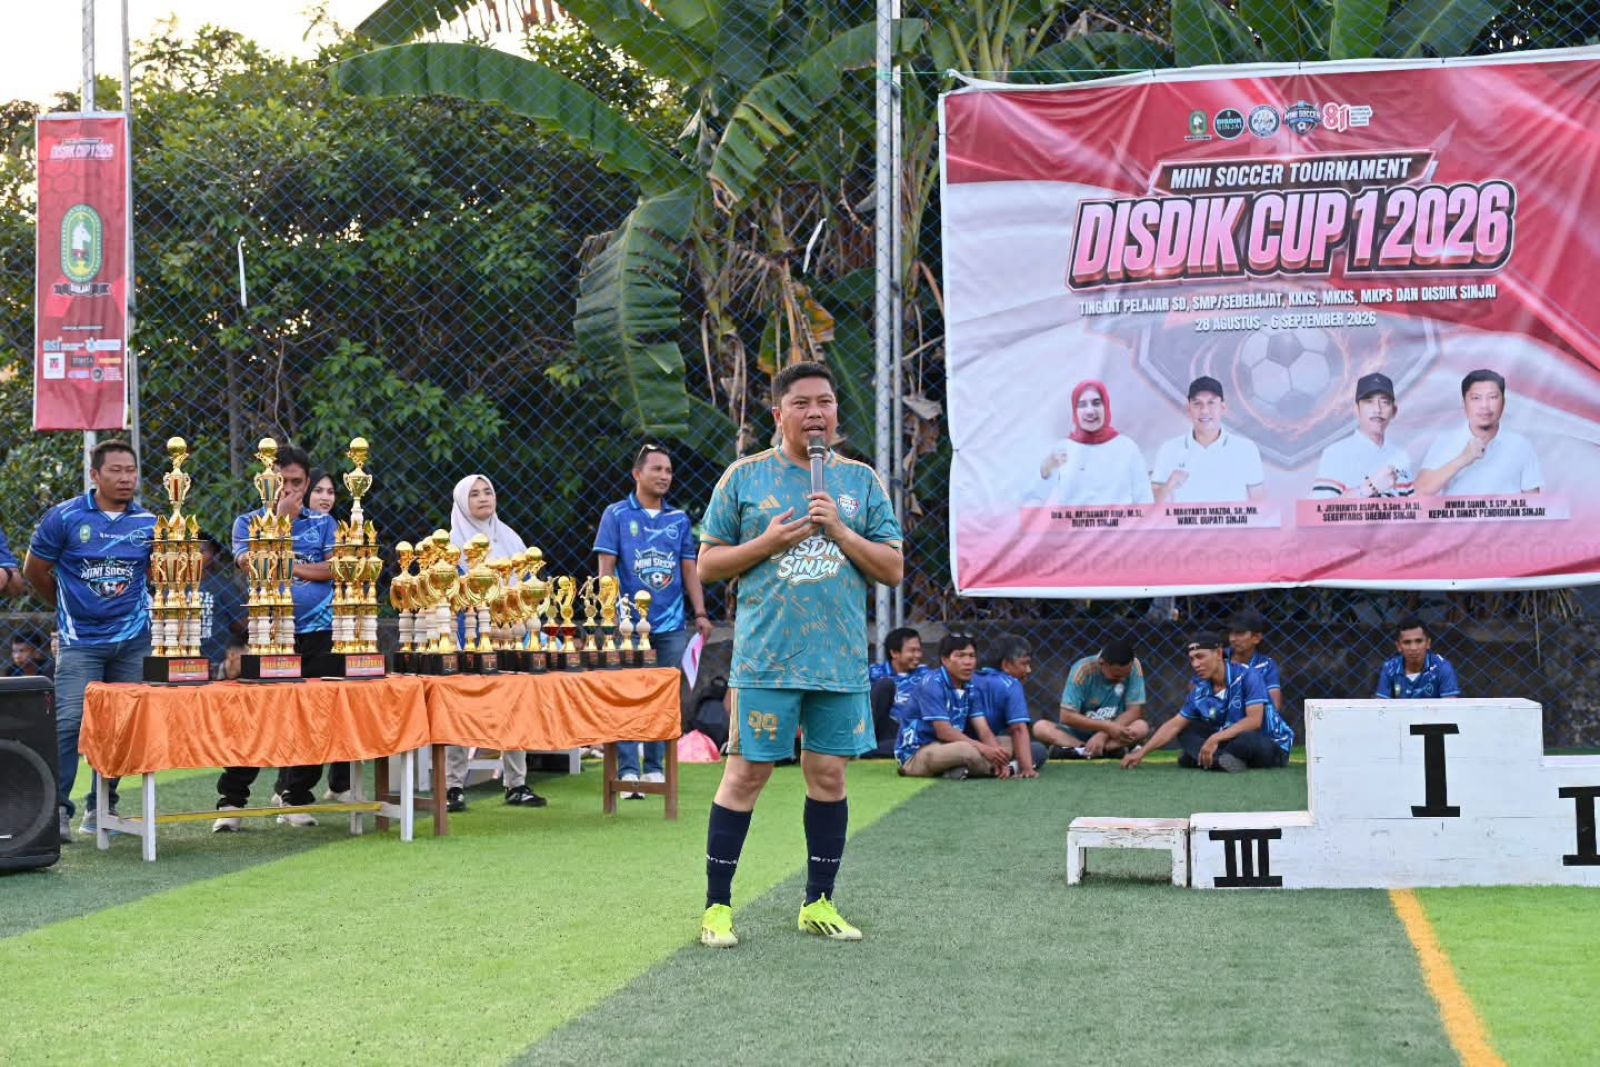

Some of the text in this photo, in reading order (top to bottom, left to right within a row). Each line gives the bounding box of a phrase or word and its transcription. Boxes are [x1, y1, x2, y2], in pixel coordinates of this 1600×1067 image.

[1171, 158, 1412, 189] MINI SOCCER TOURNAMENT
[1070, 182, 1512, 284] DISDIK CUP 1 2026
[1080, 299, 1121, 316] TINGKAT
[1123, 297, 1170, 314] PELAJAR
[1171, 297, 1190, 313] SD,
[1192, 292, 1287, 311] SMP/SEDERAJAT,
[1322, 290, 1359, 307] MKKS,
[1360, 288, 1394, 304] MKPS
[1396, 287, 1419, 302] DAN
[1421, 285, 1458, 301] DISDIK
[1459, 284, 1496, 299] SINJAI
[1195, 318, 1210, 333] 28
[1212, 316, 1261, 332] AGUSTUS
[1281, 311, 1344, 329] SEPTEMBER
[1346, 310, 1377, 326] 2026
[1428, 506, 1546, 519] KEPALA DINAS PENDIDIKAN SINJAI
[748, 710, 779, 742] 99
[1409, 723, 1461, 818] I
[1208, 828, 1283, 888] III
